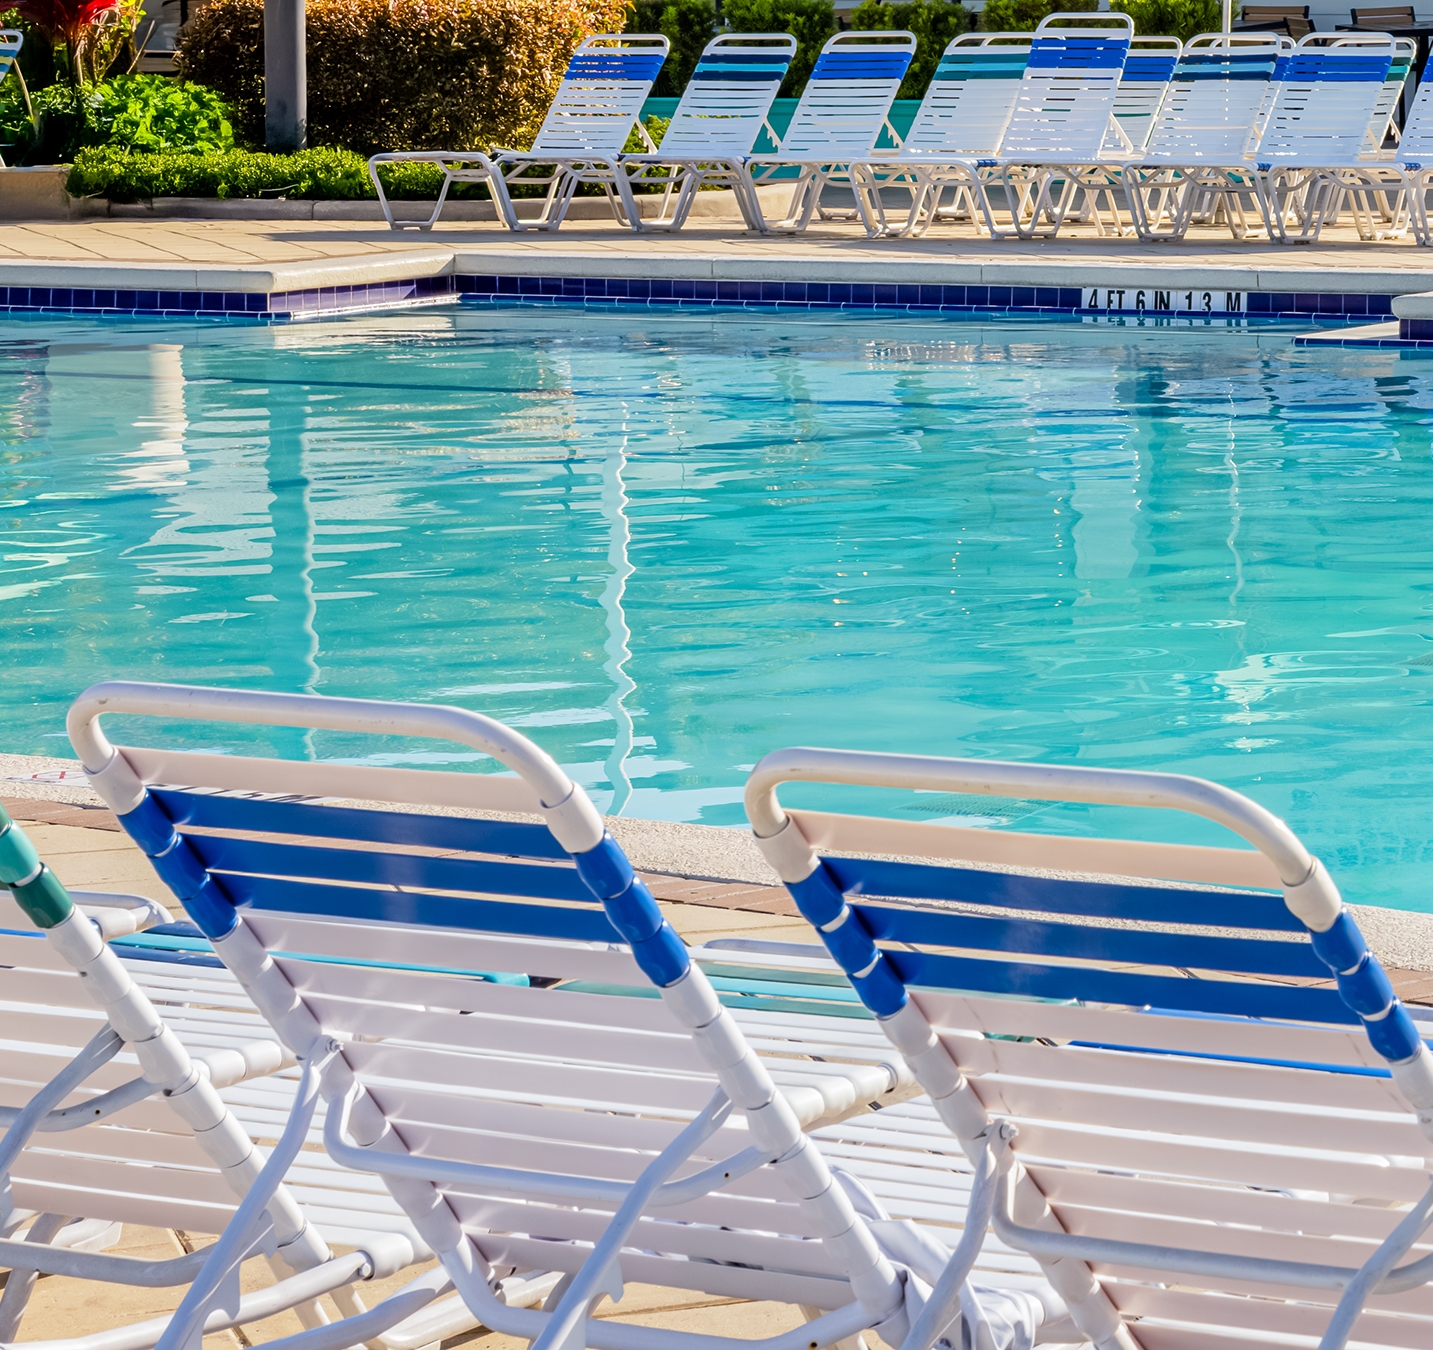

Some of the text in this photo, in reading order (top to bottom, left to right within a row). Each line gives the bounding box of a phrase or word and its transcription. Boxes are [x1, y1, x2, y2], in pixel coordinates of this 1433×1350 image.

[1088, 289, 1098, 308] 4
[1107, 290, 1125, 309] FT
[1136, 290, 1145, 310] 6
[1154, 291, 1170, 310] IN
[1226, 292, 1241, 312] M
